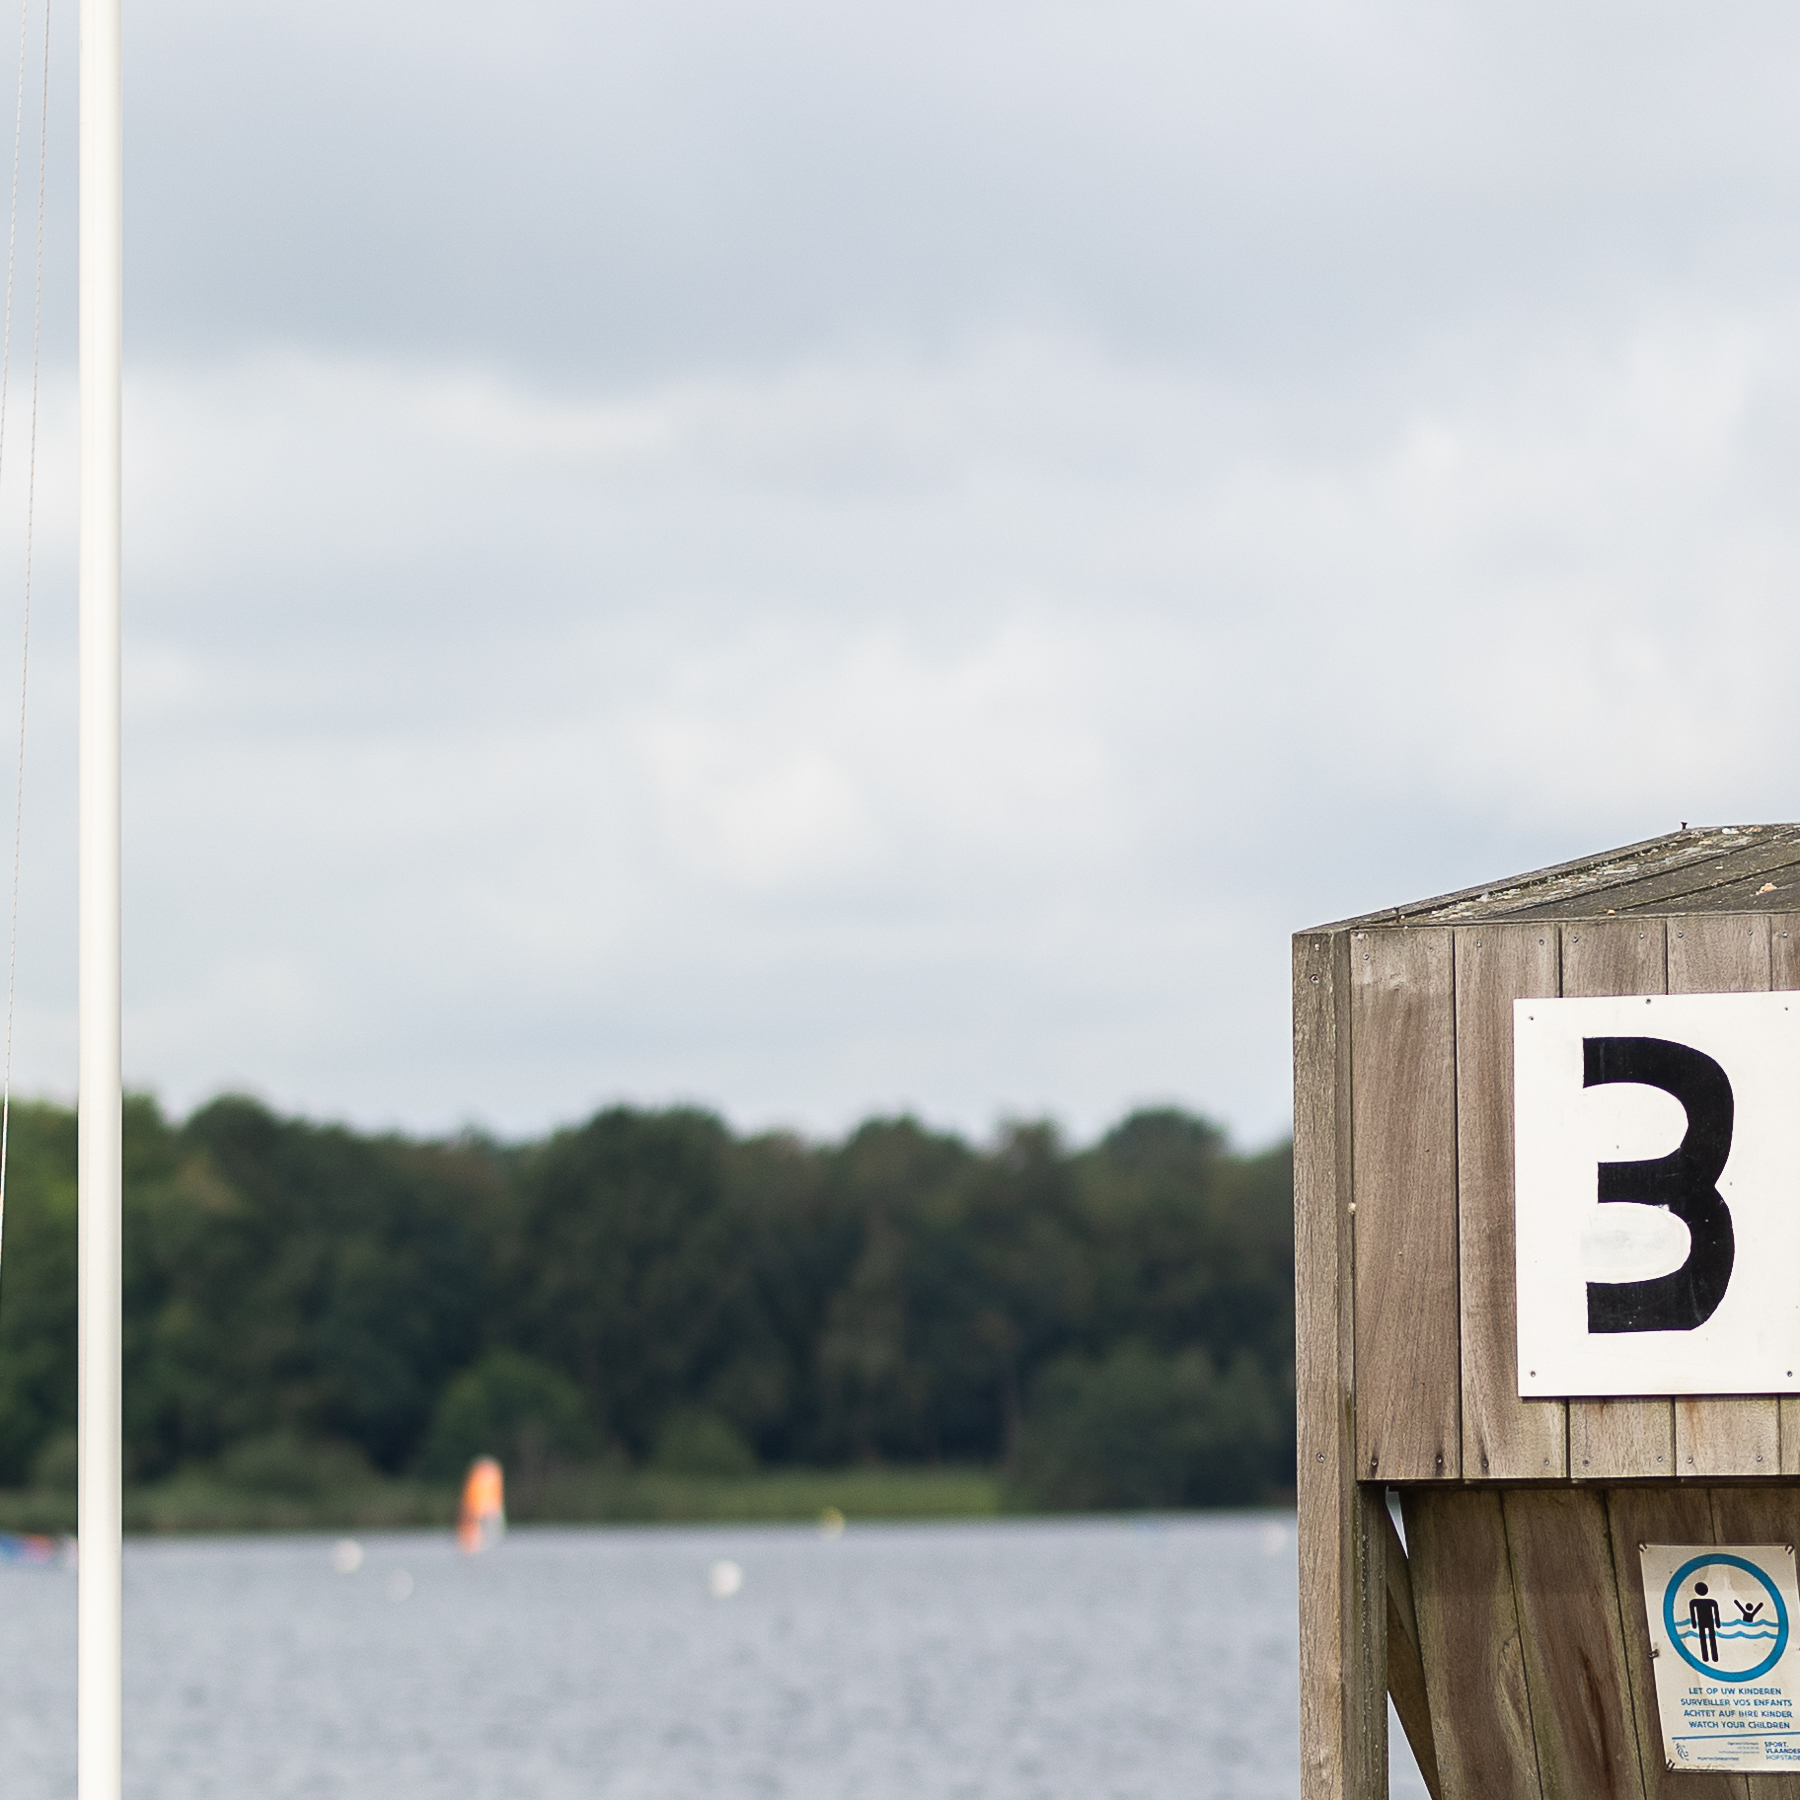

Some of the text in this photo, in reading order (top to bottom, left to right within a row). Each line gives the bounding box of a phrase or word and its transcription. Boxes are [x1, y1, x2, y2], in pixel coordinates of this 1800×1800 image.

[1582, 1036, 1735, 1334] 3
[1688, 1687, 1782, 1695] LET OP UW KINDEREN
[1680, 1698, 1731, 1706] SURVEILLER
[1753, 1699, 1793, 1707] ENFANTS
[1683, 1709, 1715, 1717] ACHTET
[1761, 1710, 1793, 1718] KINDER
[1747, 1721, 1790, 1729] CHILDREN
